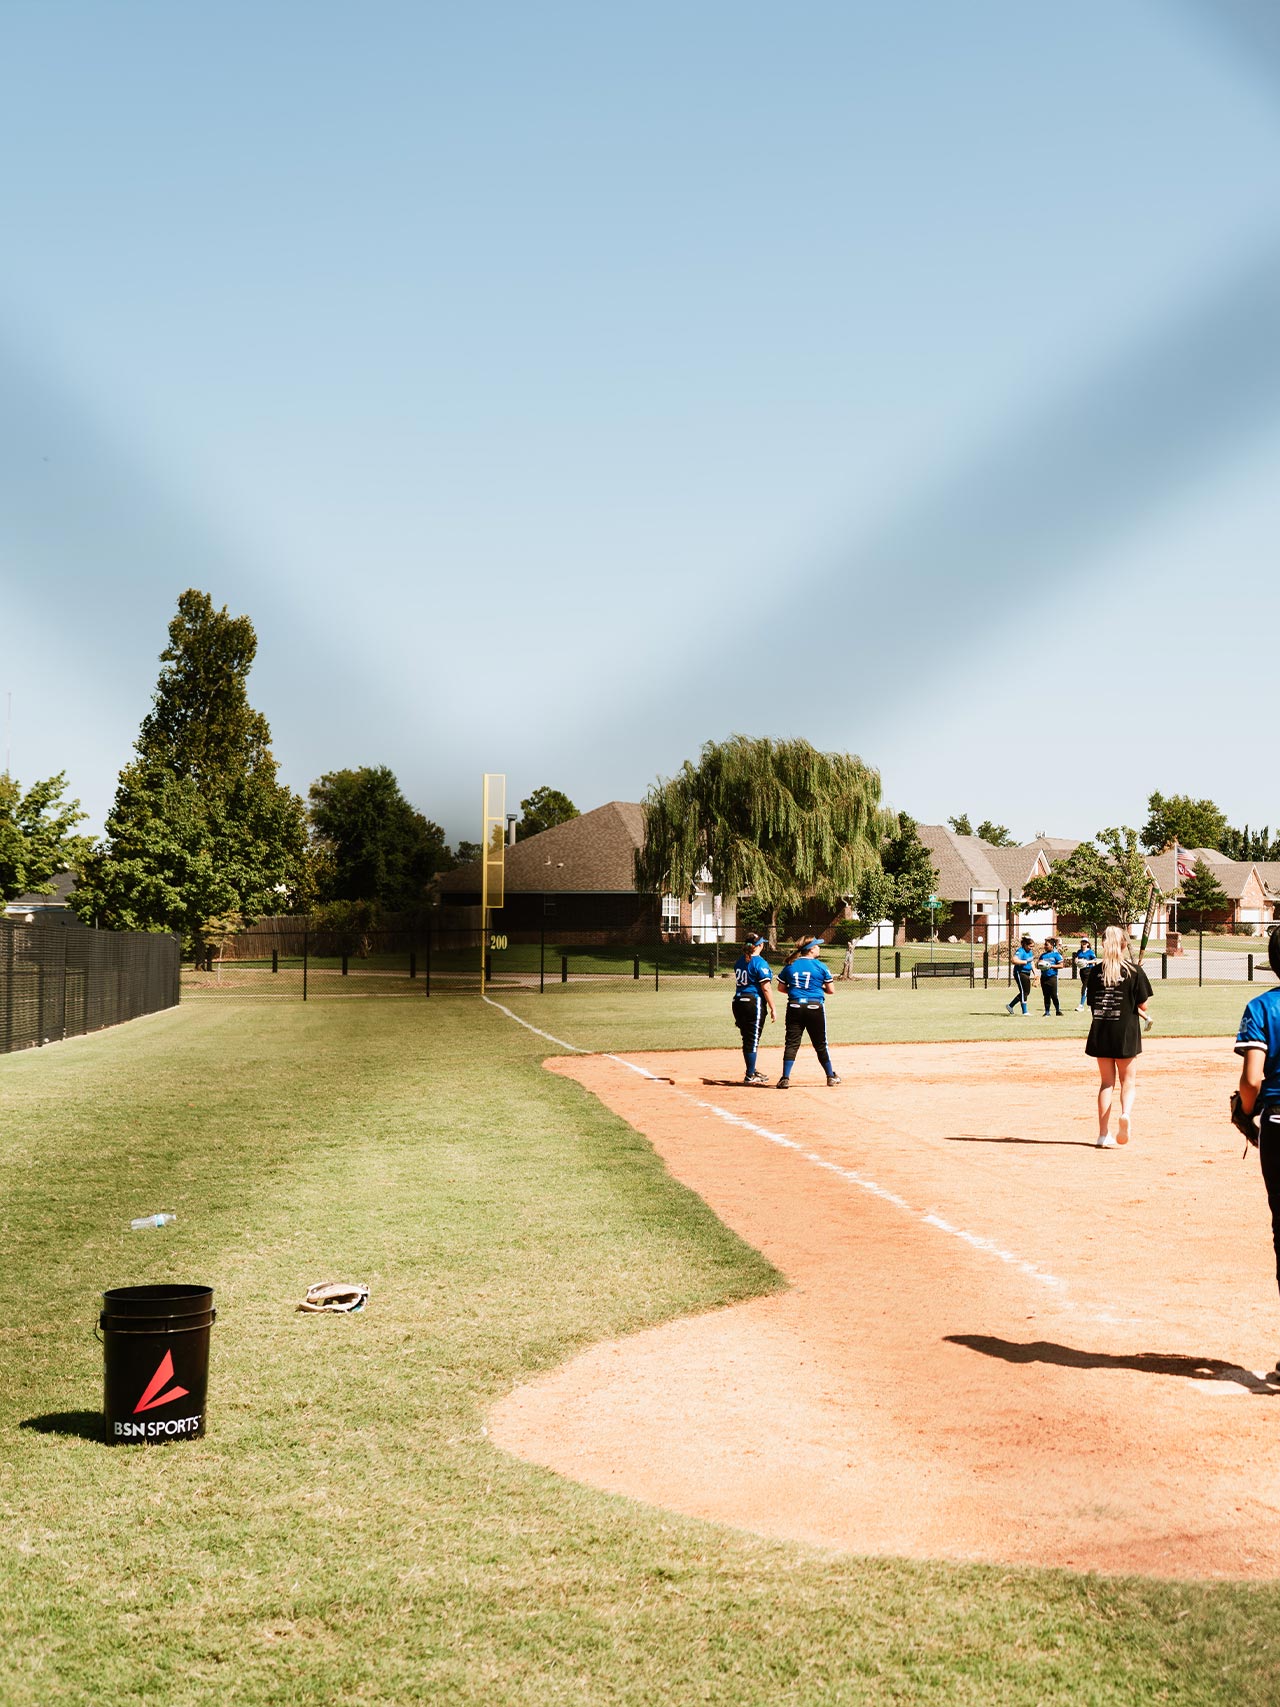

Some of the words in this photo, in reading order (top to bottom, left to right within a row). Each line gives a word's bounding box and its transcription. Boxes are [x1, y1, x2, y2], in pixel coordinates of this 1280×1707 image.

[490, 935, 508, 950] 200
[735, 968, 748, 986] 20
[793, 971, 811, 989] 17
[114, 1421, 145, 1437] BSN
